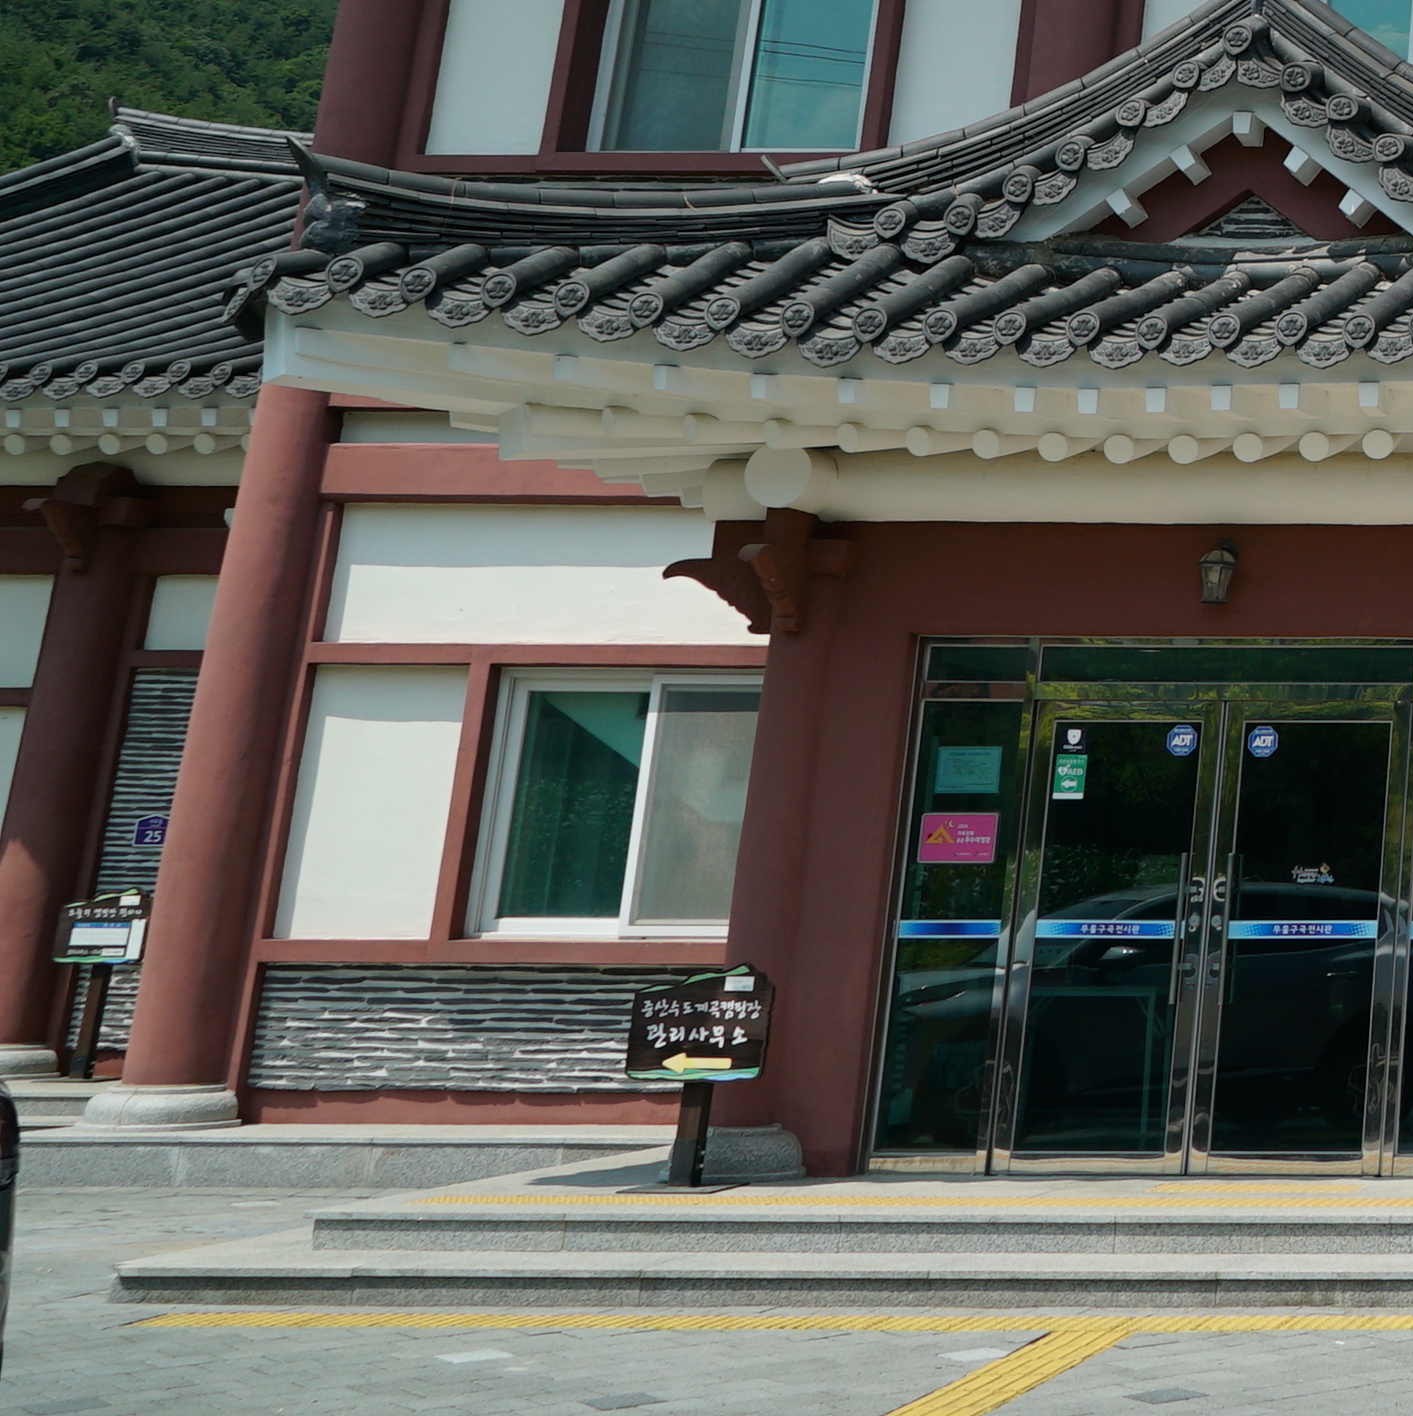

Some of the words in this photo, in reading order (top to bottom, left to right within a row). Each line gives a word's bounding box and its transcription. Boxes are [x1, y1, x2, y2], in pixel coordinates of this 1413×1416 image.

[1170, 734, 1194, 747] ADT
[1251, 735, 1275, 748] ADT
[1067, 767, 1084, 776] AED
[143, 830, 162, 843] 25
[1080, 924, 1140, 934] 무흘구곡전시관
[1273, 924, 1333, 934] 무흘구곡전시관
[646, 1022, 748, 1049] 관리사무소
